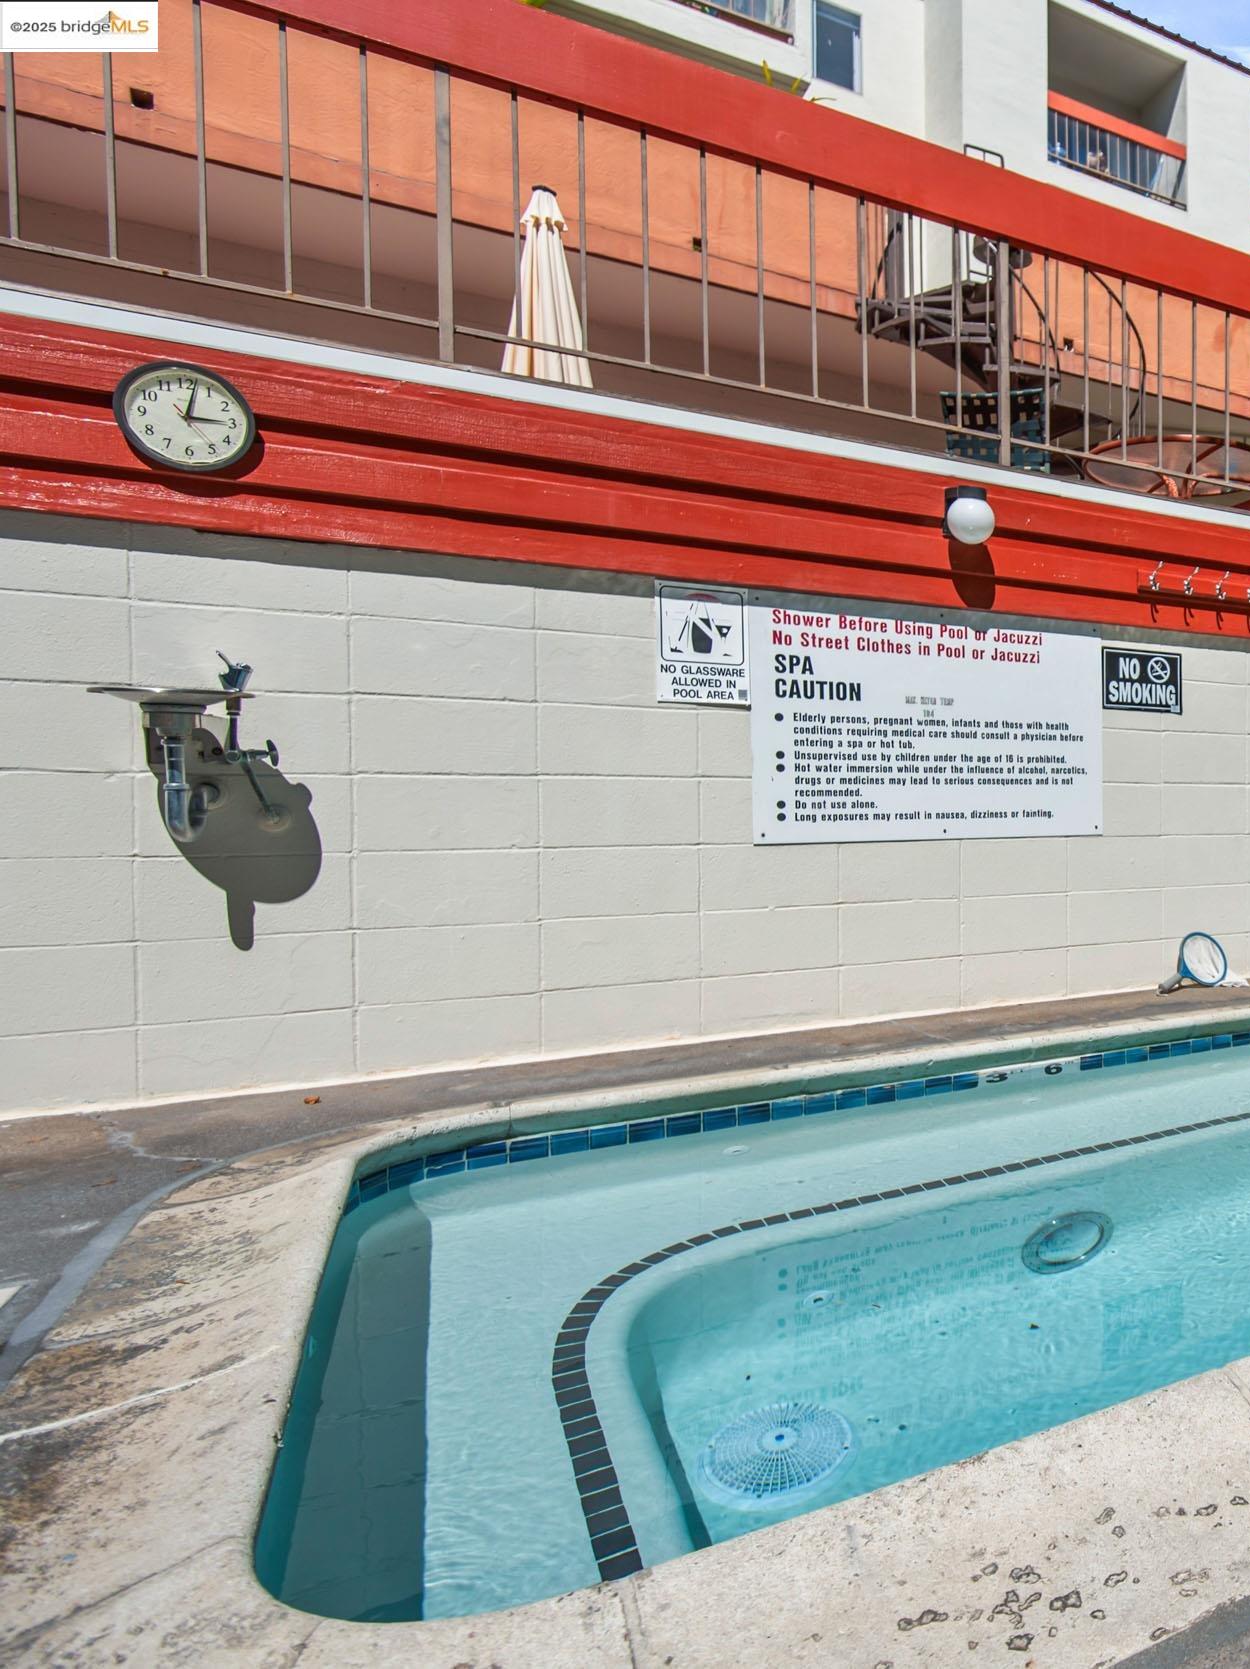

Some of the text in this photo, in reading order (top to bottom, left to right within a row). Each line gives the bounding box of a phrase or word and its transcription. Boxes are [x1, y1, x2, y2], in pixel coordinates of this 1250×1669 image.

[158, 379, 171, 392] 11
[177, 377, 194, 391] 12
[141, 389, 157, 402] 10
[137, 405, 147, 417] 9
[220, 400, 230, 412] 2
[228, 417, 237, 429] 3
[145, 424, 154, 436] 8
[163, 438, 172, 449] 7
[222, 434, 231, 445] 4
[185, 445, 194, 457] 6
[207, 443, 216, 455] 5
[772, 609, 1042, 646] Shower Before Using Pool or Jacuzzi
[772, 630, 1040, 664] No Street Clothes in Pool or Jacuzzi
[774, 654, 814, 675] SPA
[1118, 656, 1140, 680] NO
[660, 664, 746, 678] NO GLASSWARE
[671, 676, 736, 688] ALLOWED IN
[673, 688, 702, 698] POOL
[706, 690, 734, 700] AREA
[775, 678, 862, 702] CAUTION
[1108, 680, 1176, 706] SMOKING
[793, 712, 1069, 730] Elderly persons, pregnant women, infants and those with health
[794, 726, 842, 736] conditions
[846, 727, 888, 738] requiring
[892, 728, 925, 738] medical
[928, 730, 948, 738] care
[950, 730, 978, 739] should
[981, 732, 1010, 740] consult
[1021, 732, 1057, 742] physician
[1060, 734, 1084, 742] before
[794, 738, 834, 748] entering
[838, 740, 843, 748] a
[847, 740, 863, 749] spa
[867, 740, 876, 748] or
[880, 740, 894, 748] hot
[794, 750, 858, 761] Unsupervised
[881, 752, 892, 762] by
[896, 752, 930, 762] children
[934, 754, 957, 762] under
[961, 754, 974, 762] the
[977, 756, 991, 764] age
[994, 754, 1002, 763] of
[1006, 754, 1014, 763] 16
[1016, 754, 1024, 763] is
[1027, 755, 1068, 764] prohibited.
[794, 763, 1088, 775] Hot water immersion while under the influence of alcohol, narcotics,
[794, 776, 822, 786] drugs
[840, 776, 885, 785] medicines
[888, 777, 906, 786] may
[910, 776, 928, 784] lead
[932, 777, 940, 785] to
[944, 777, 974, 785] serious
[978, 778, 1032, 786] consequences
[1036, 777, 1049, 785] and
[1052, 777, 1058, 785] is
[1061, 777, 1074, 785] not
[794, 788, 862, 797] recommended.
[795, 800, 807, 809] Do
[811, 800, 826, 809] not
[851, 800, 878, 809] alone.
[794, 810, 1054, 822] Long exposures may result in nausea, dizziness or fainting.
[1044, 1063, 1063, 1075] 6
[986, 1072, 1008, 1083] 3
